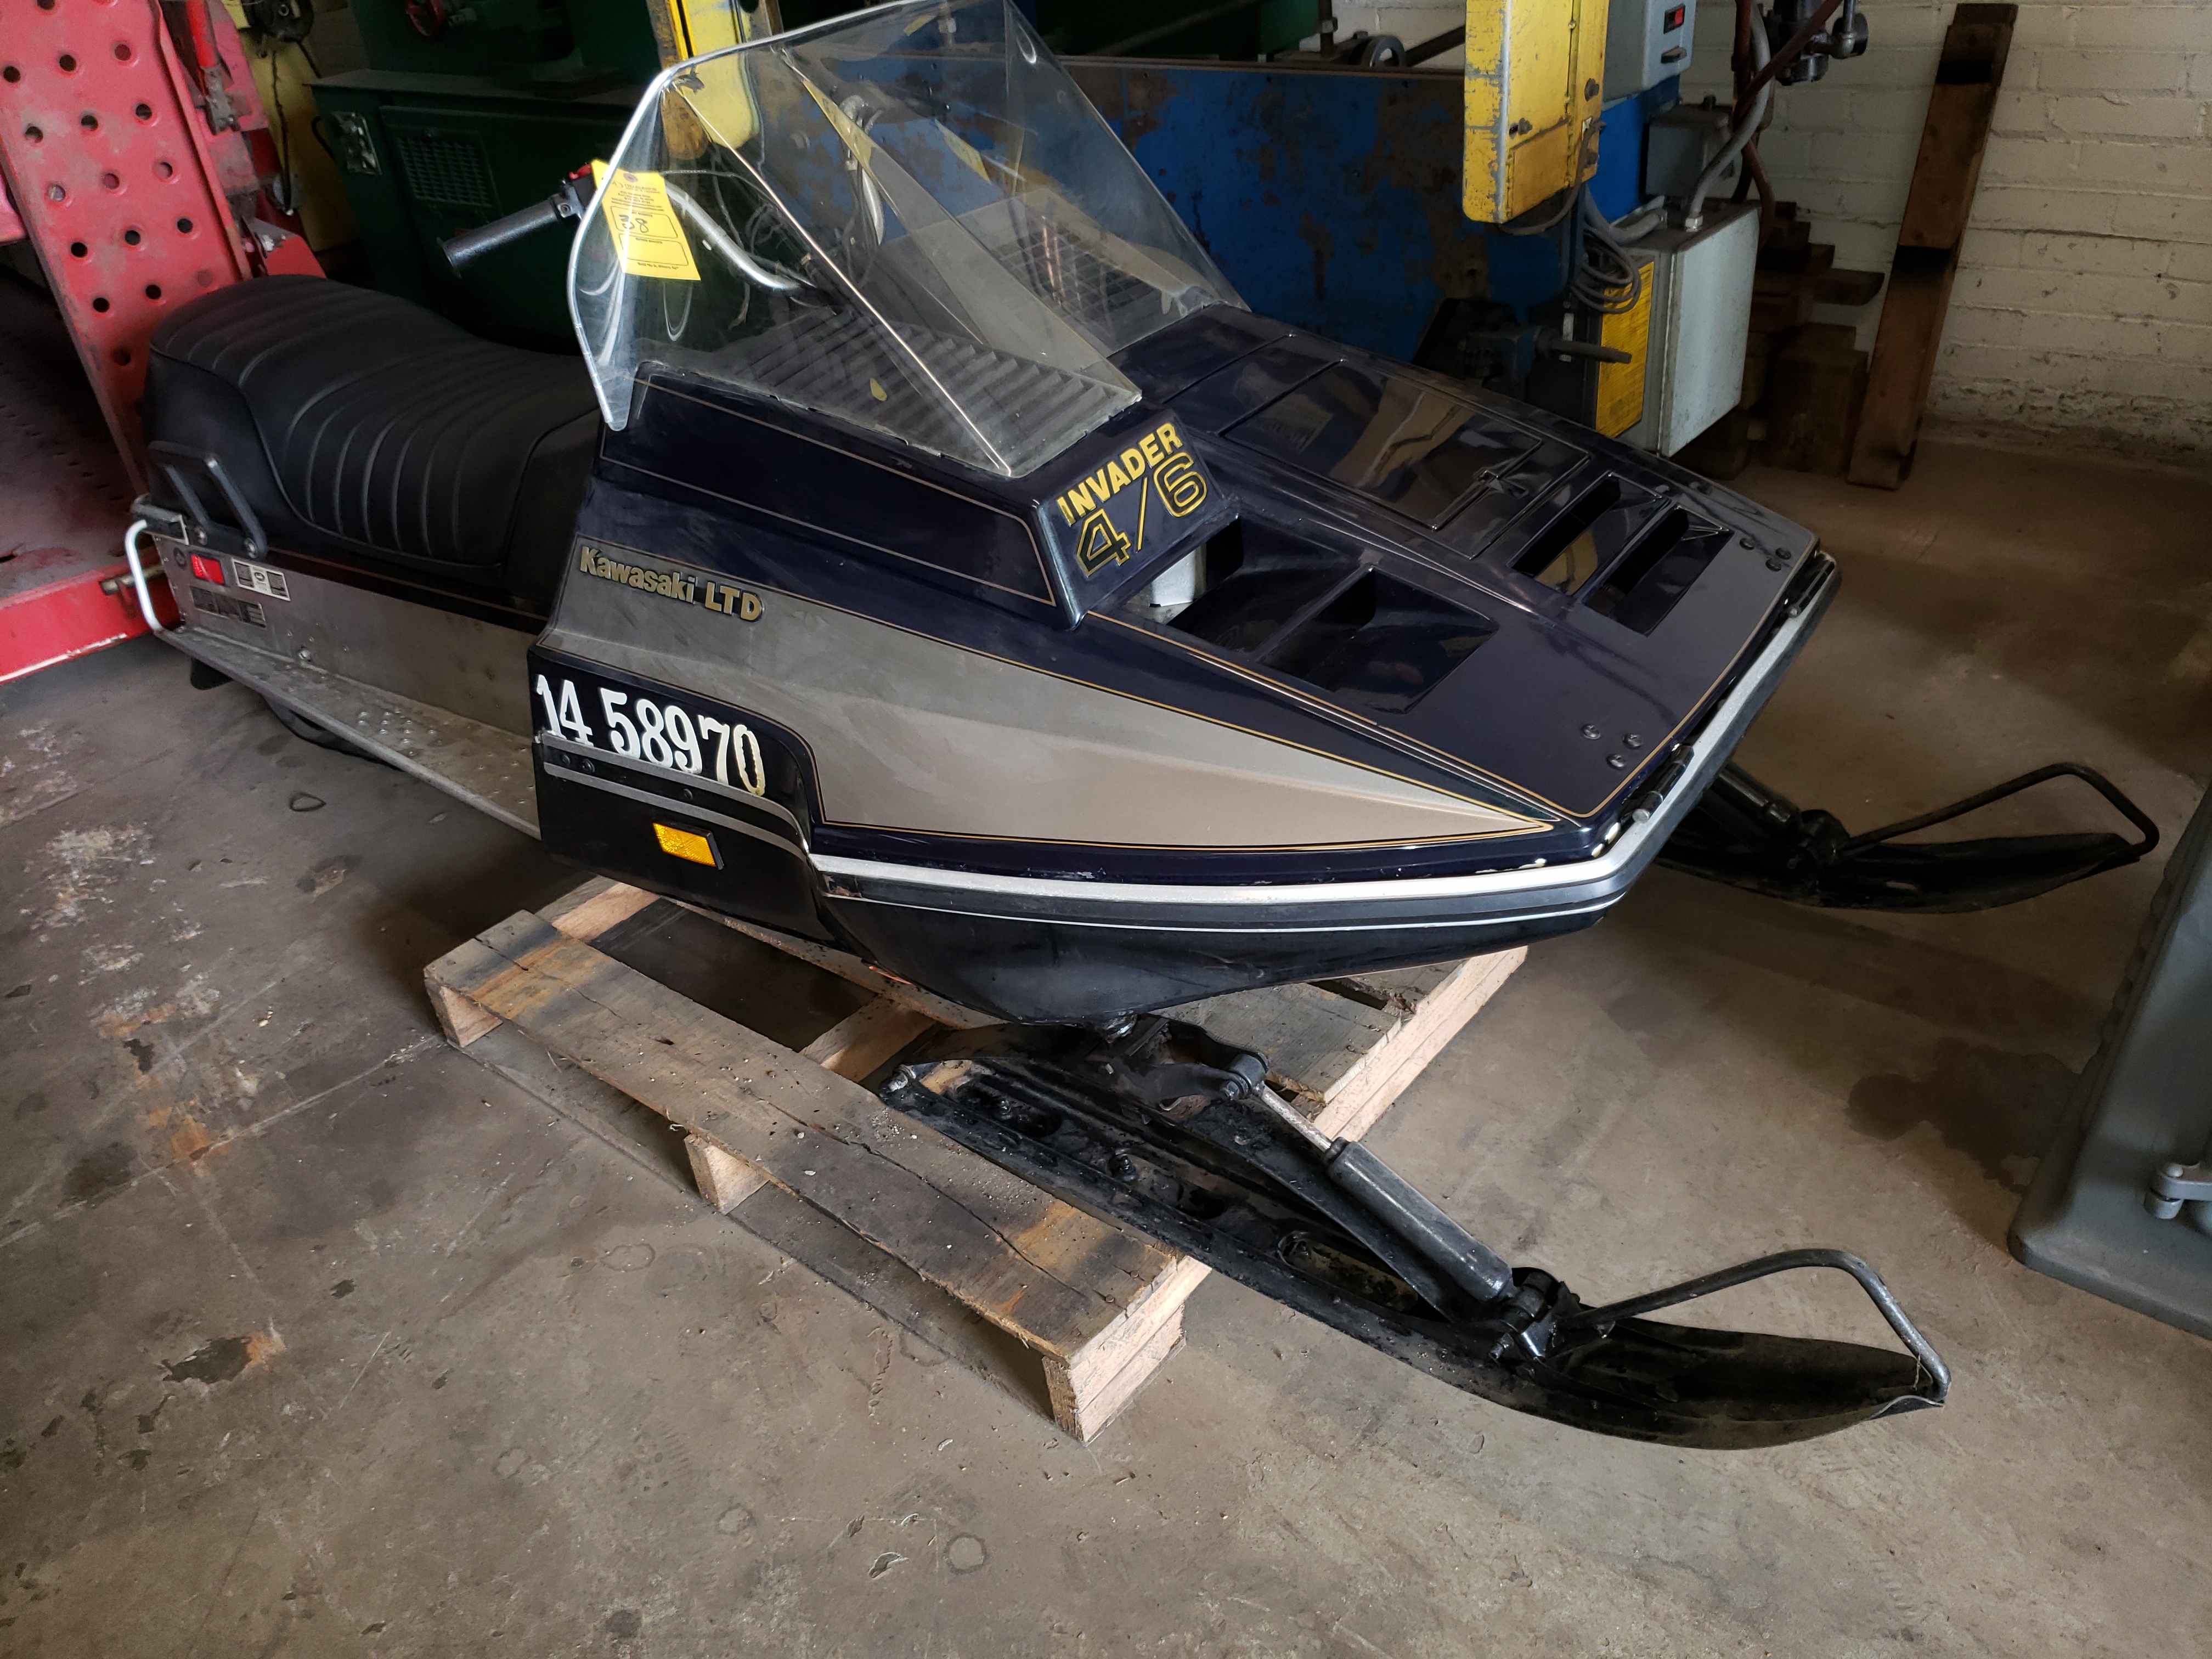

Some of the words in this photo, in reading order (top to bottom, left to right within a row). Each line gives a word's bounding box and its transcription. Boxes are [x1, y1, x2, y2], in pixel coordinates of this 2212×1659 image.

[618, 214, 649, 234] 38
[1056, 422, 1183, 527] INVADER
[1076, 452, 1207, 577] 4/6
[580, 546, 698, 605] Kawasaki
[704, 581, 766, 622] LTD
[536, 674, 594, 747] 14
[600, 687, 766, 796] 58970
